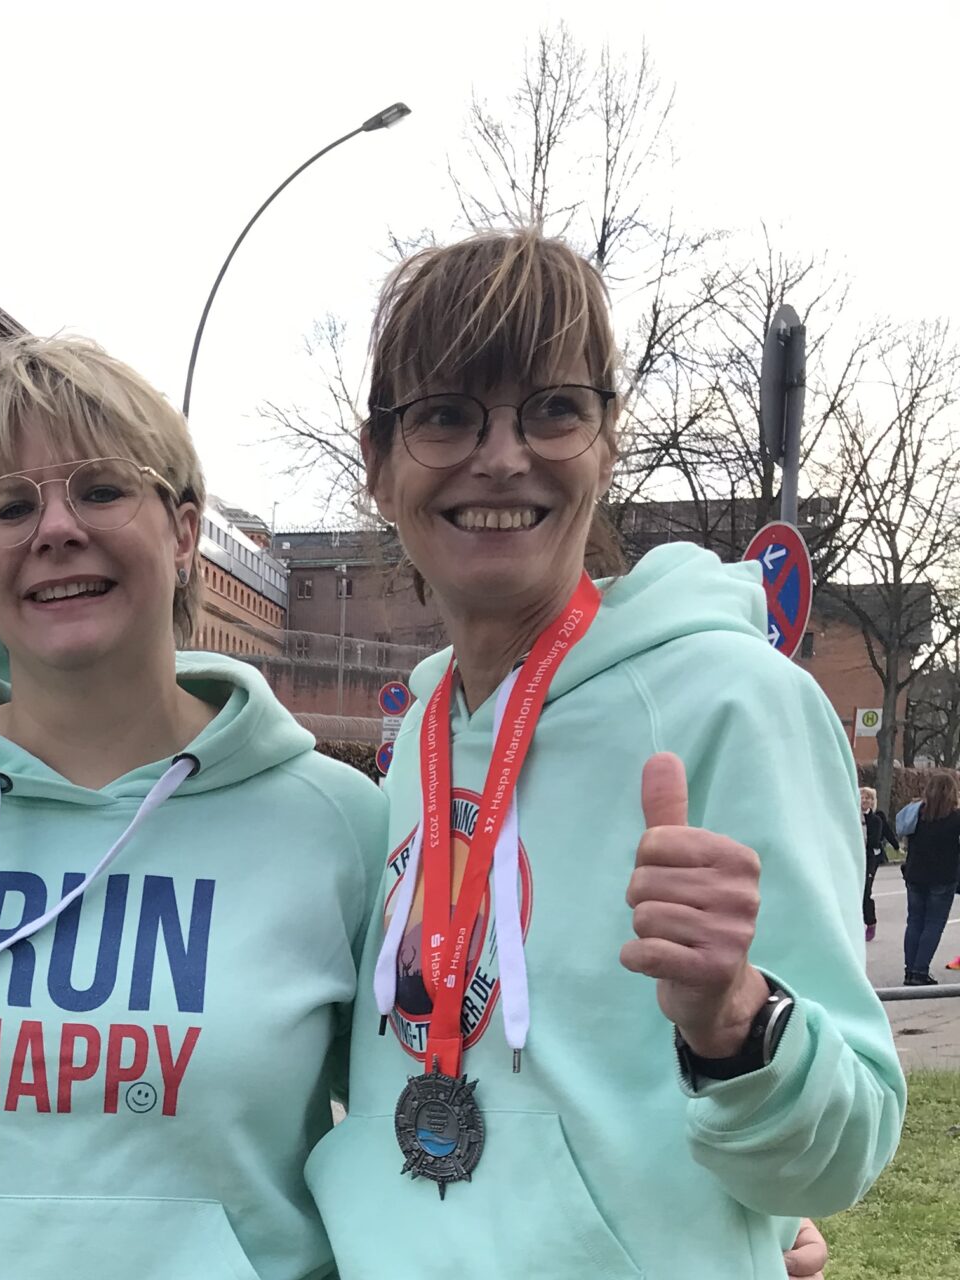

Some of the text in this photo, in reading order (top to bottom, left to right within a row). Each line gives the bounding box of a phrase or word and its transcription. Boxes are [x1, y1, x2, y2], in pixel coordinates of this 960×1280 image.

[490, 768, 511, 810] Haspa
[504, 698, 534, 763] Marathon
[525, 640, 568, 693] Hamburg
[559, 608, 584, 638] 2023
[428, 752, 440, 813] Hamburg
[430, 815, 440, 848] 2023
[450, 928, 466, 969] Haspa
[431, 952, 441, 990] Hasp
